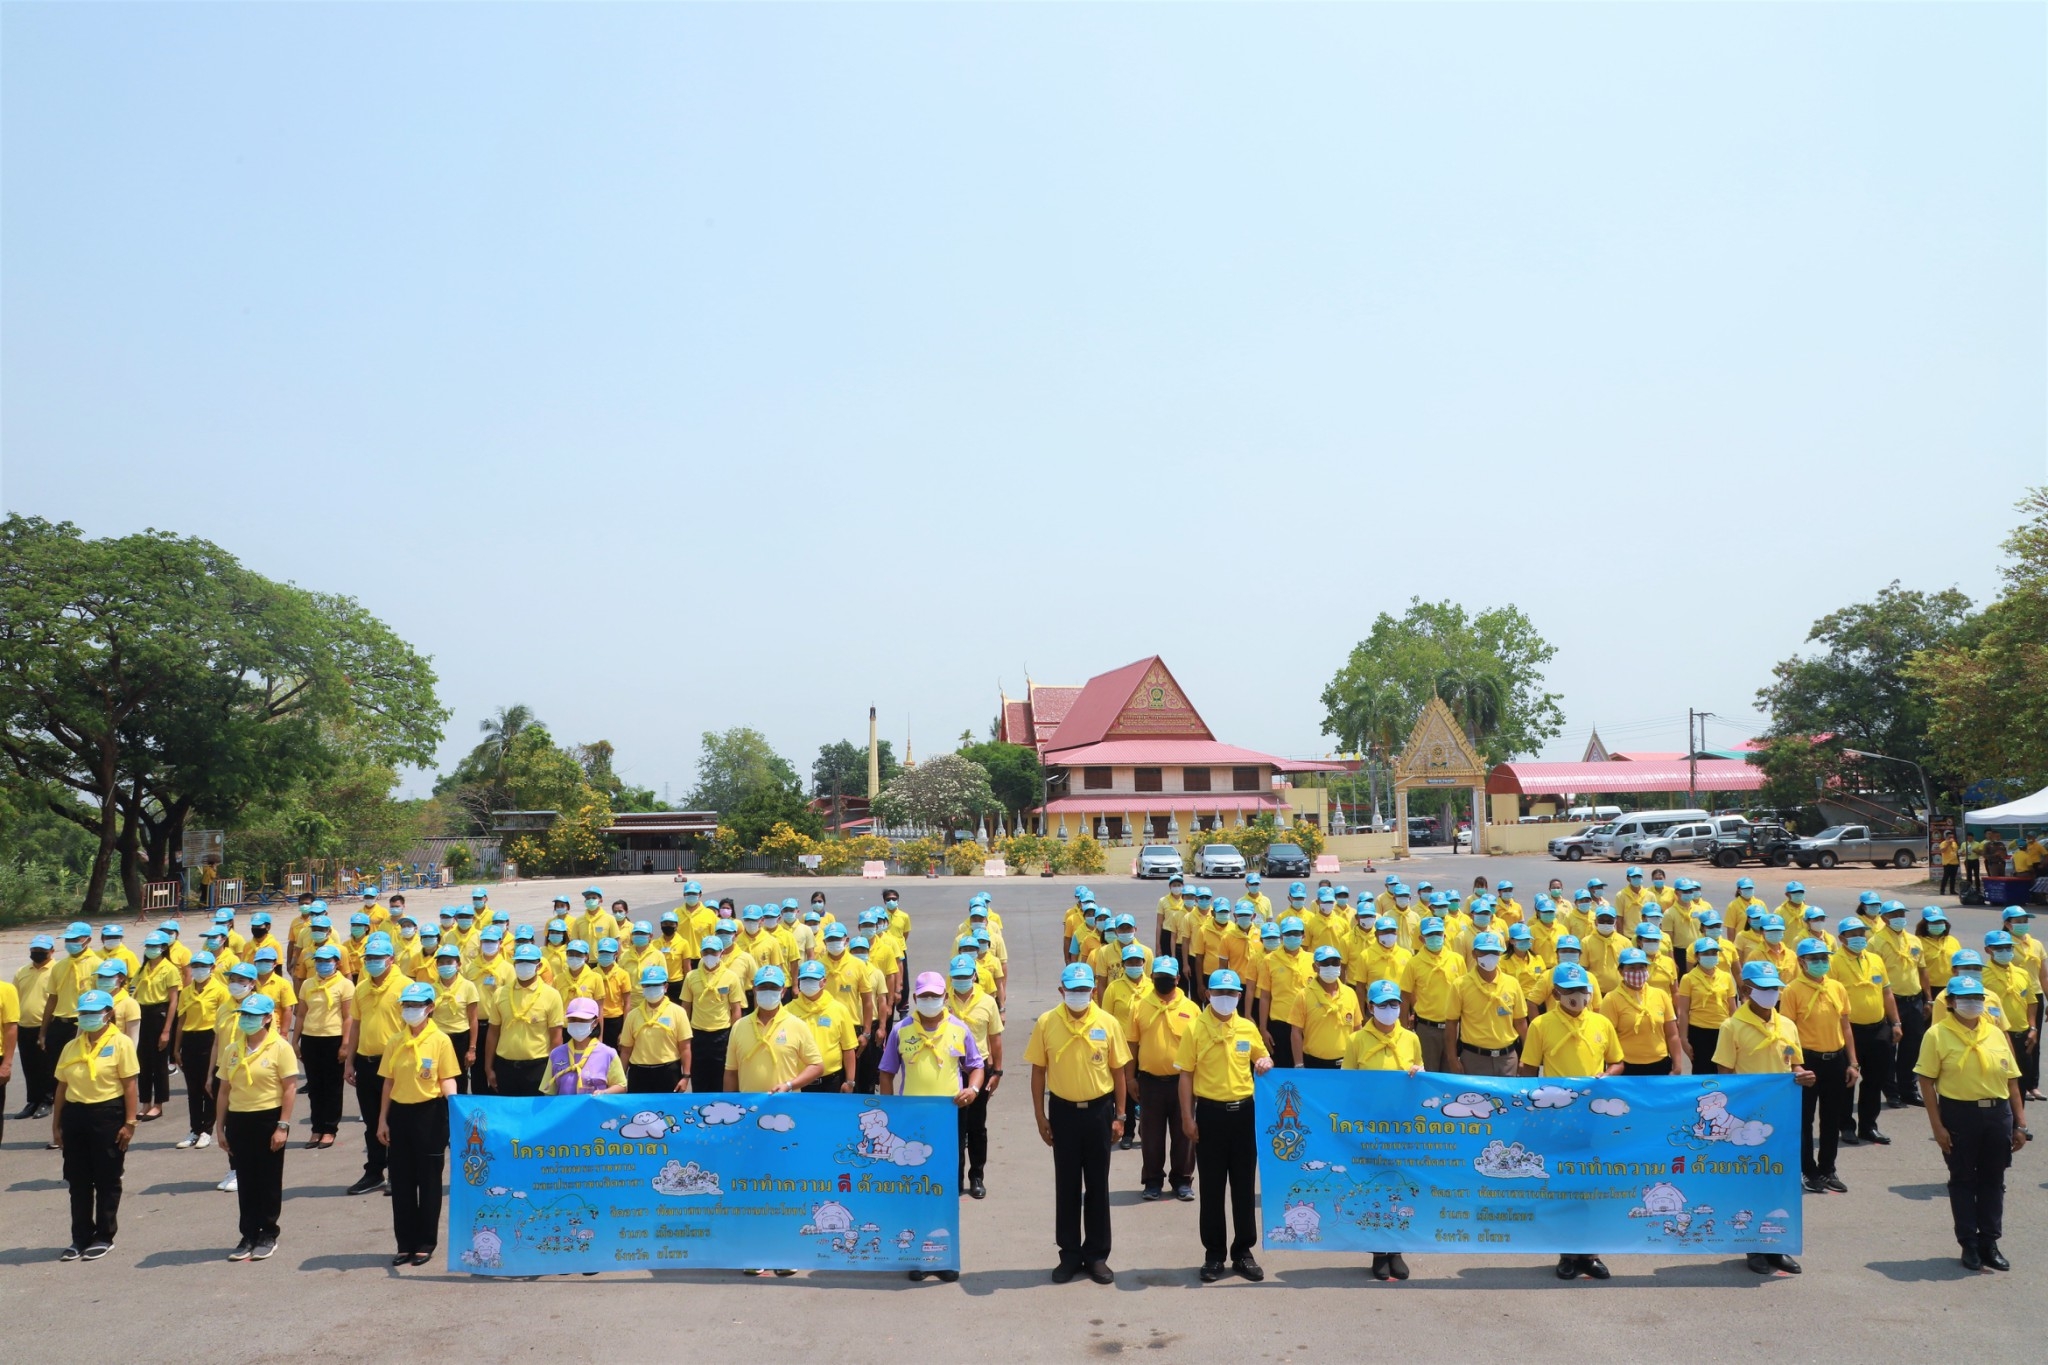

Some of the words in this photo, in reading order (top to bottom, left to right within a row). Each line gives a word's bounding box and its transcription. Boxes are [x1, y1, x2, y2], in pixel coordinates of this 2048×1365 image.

[1328, 1112, 1493, 1135] โครงการจิตอาสา
[510, 1138, 669, 1159] โครงการจิตอาสา
[1557, 1156, 1666, 1176] เราทำความ
[1672, 1156, 1686, 1174] ดี
[1691, 1154, 1784, 1176] ด้วยหัวใจ
[731, 1174, 832, 1192] เราทำความ
[838, 1173, 851, 1193] ดี
[857, 1173, 943, 1196] ด้วยหัวใจ
